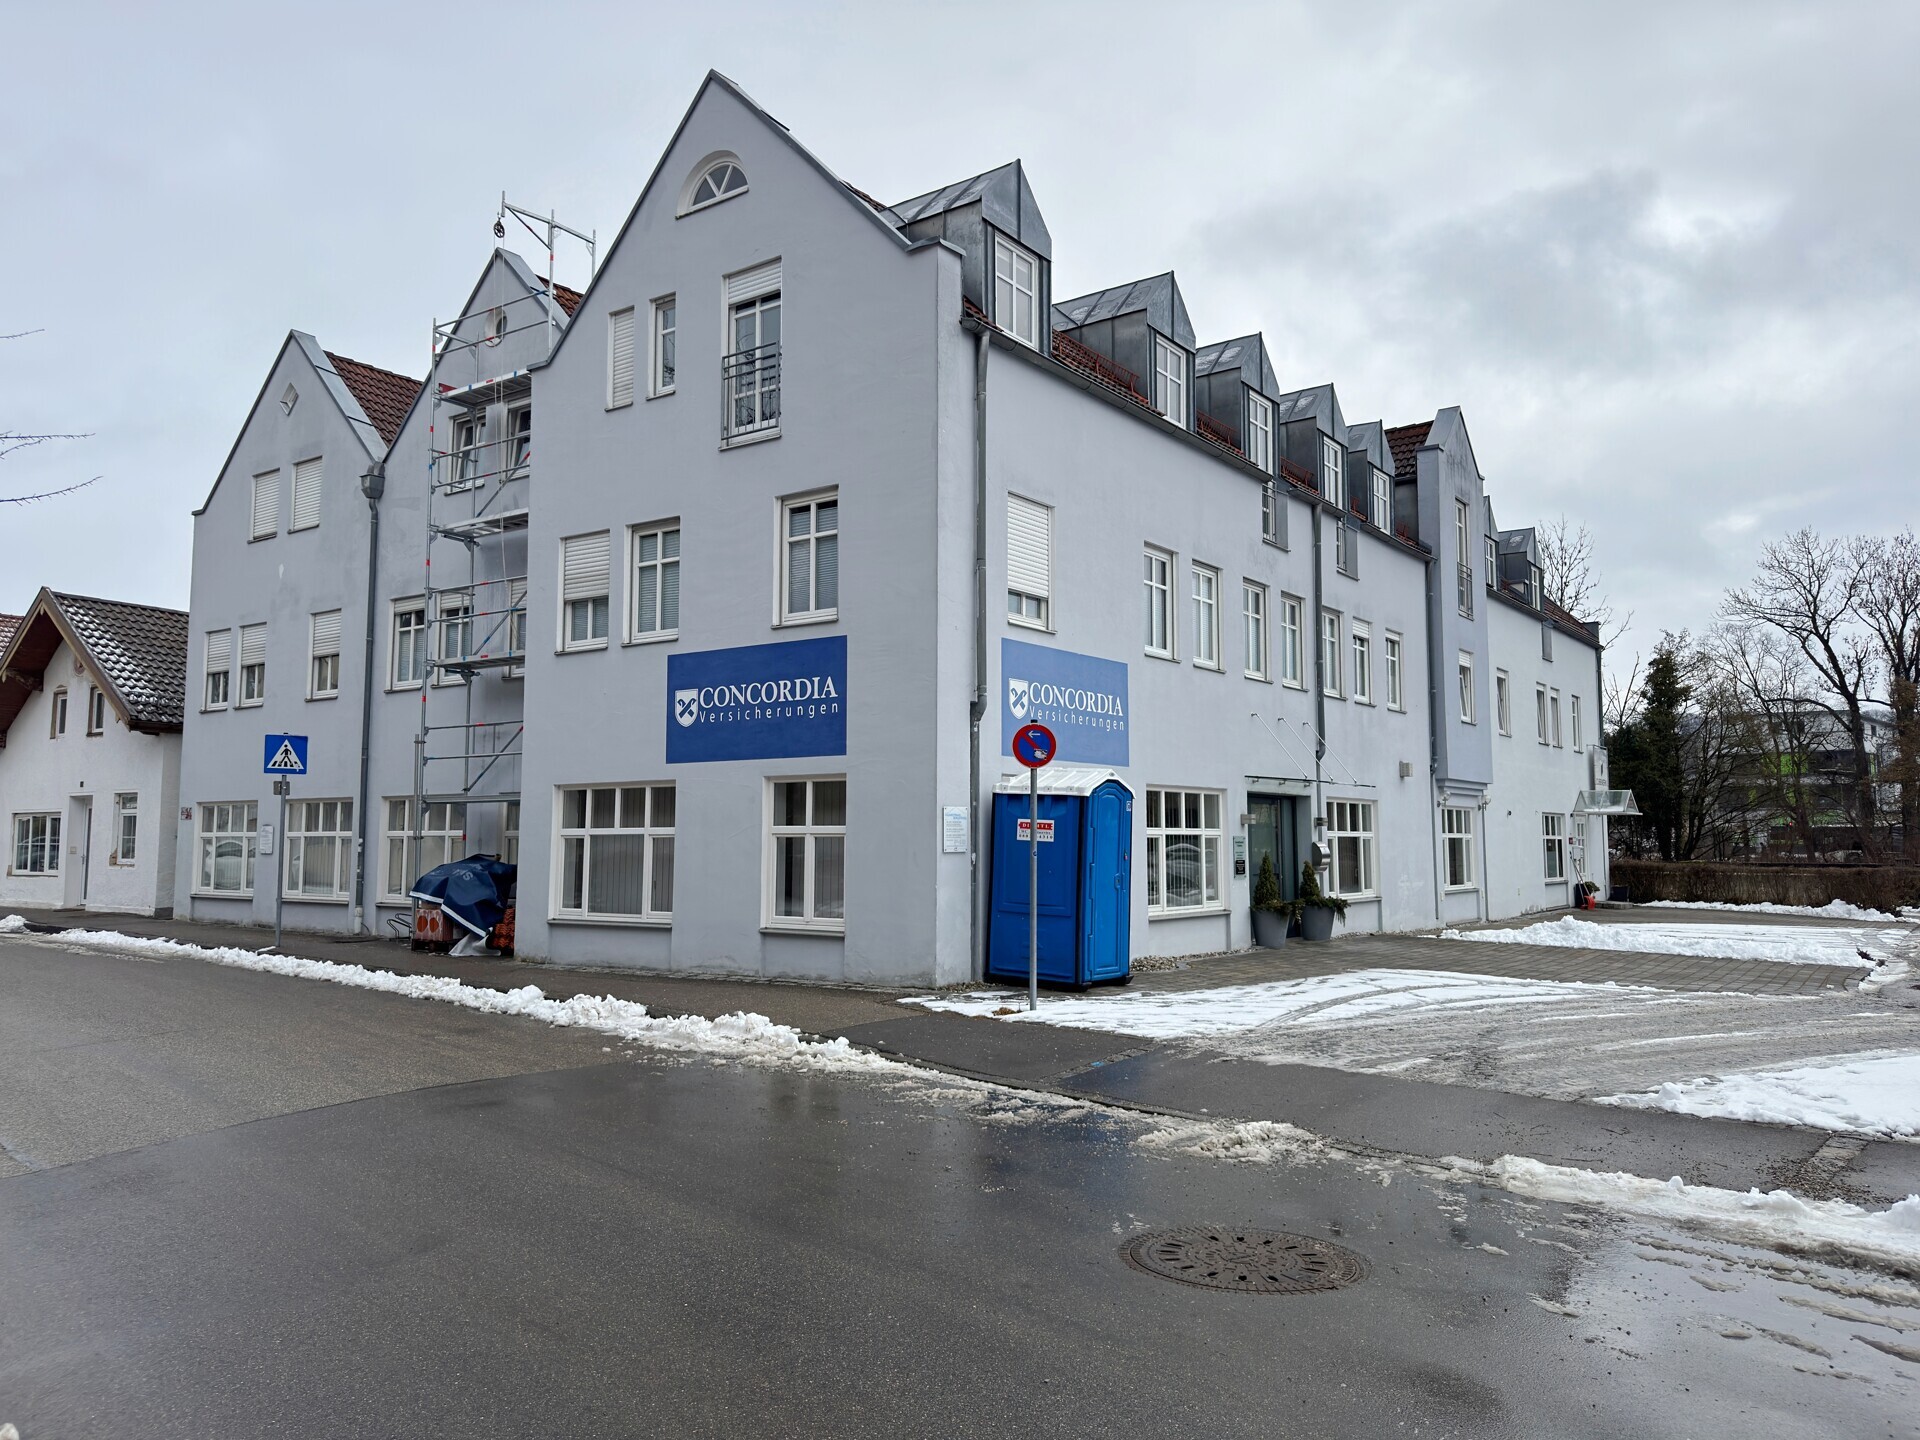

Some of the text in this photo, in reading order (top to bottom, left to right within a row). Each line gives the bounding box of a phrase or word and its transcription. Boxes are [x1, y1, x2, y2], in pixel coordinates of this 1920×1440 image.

[699, 675, 838, 708] CONCORDIA
[1029, 682, 1123, 716] CONCORDIA
[699, 703, 838, 723] Versicherungen
[1029, 705, 1124, 731] Versicherungen
